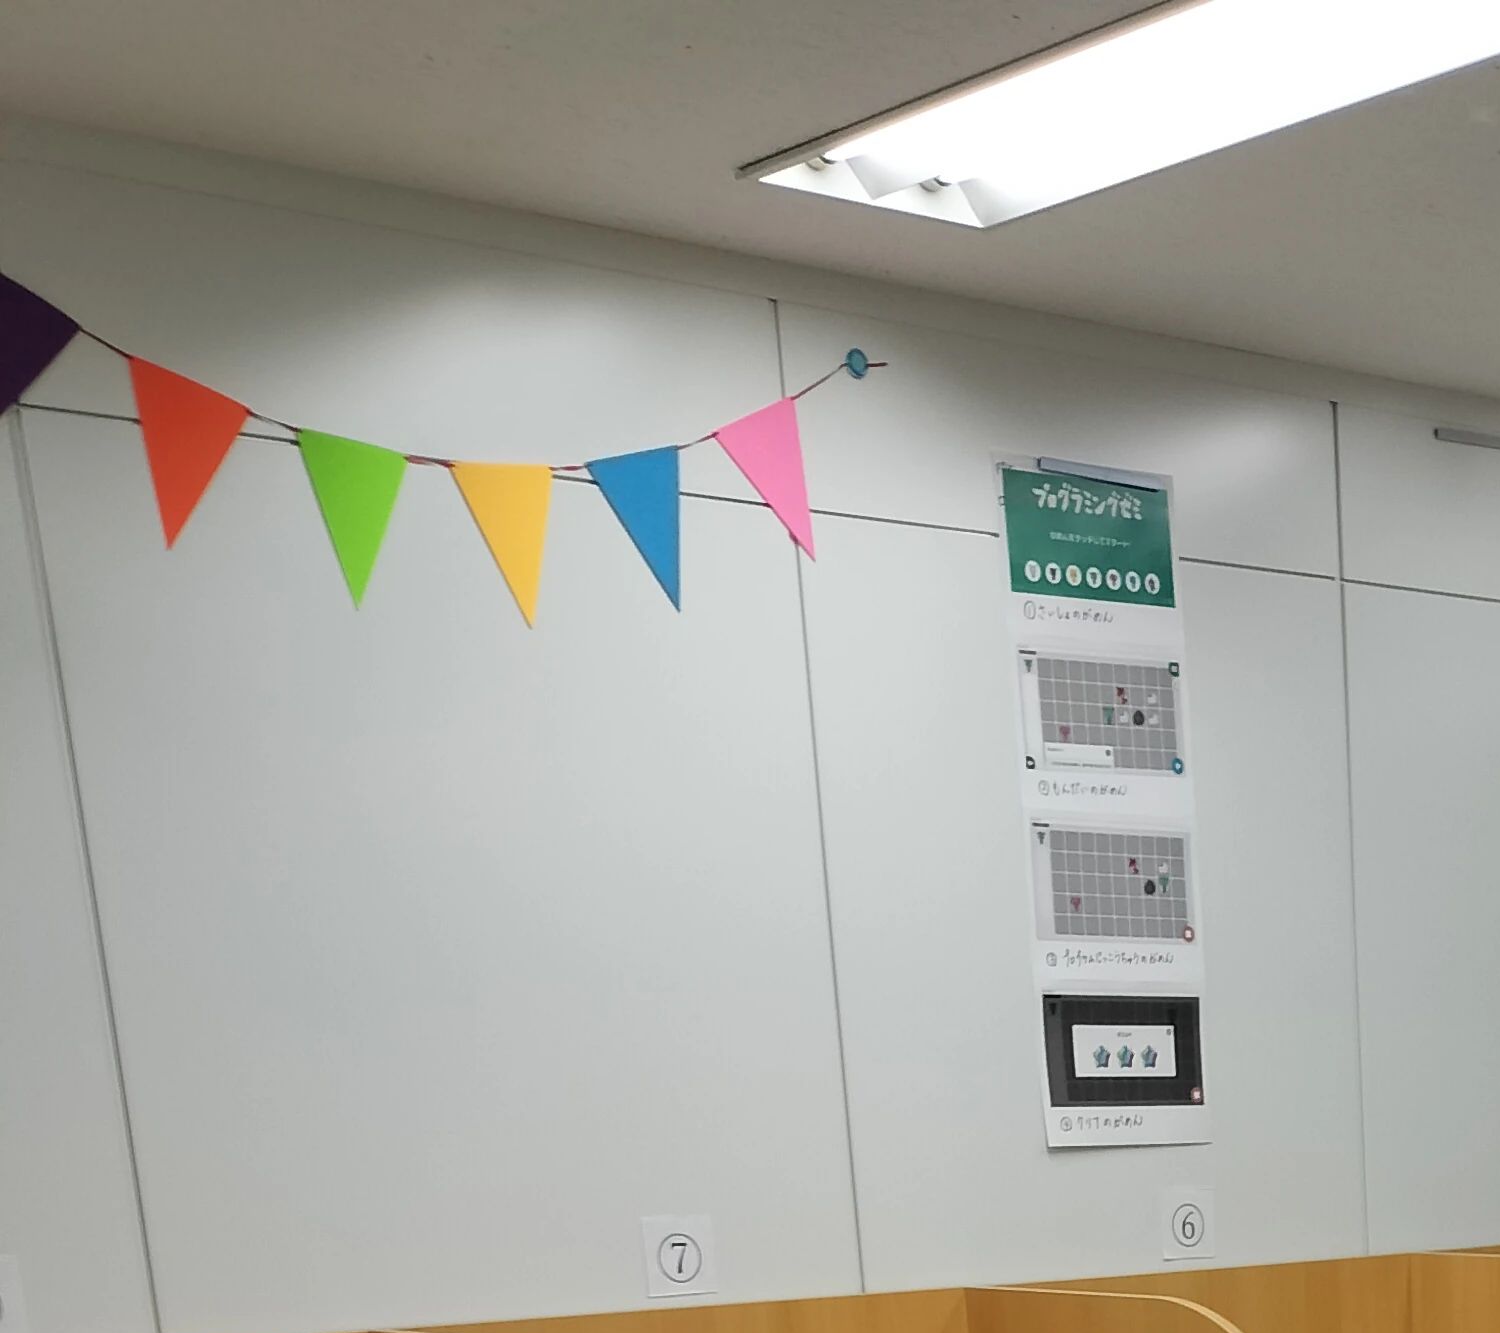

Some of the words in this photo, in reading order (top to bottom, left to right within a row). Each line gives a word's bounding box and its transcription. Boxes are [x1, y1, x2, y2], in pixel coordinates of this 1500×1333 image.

[1031, 482, 1143, 520] プログラミングゼミ
